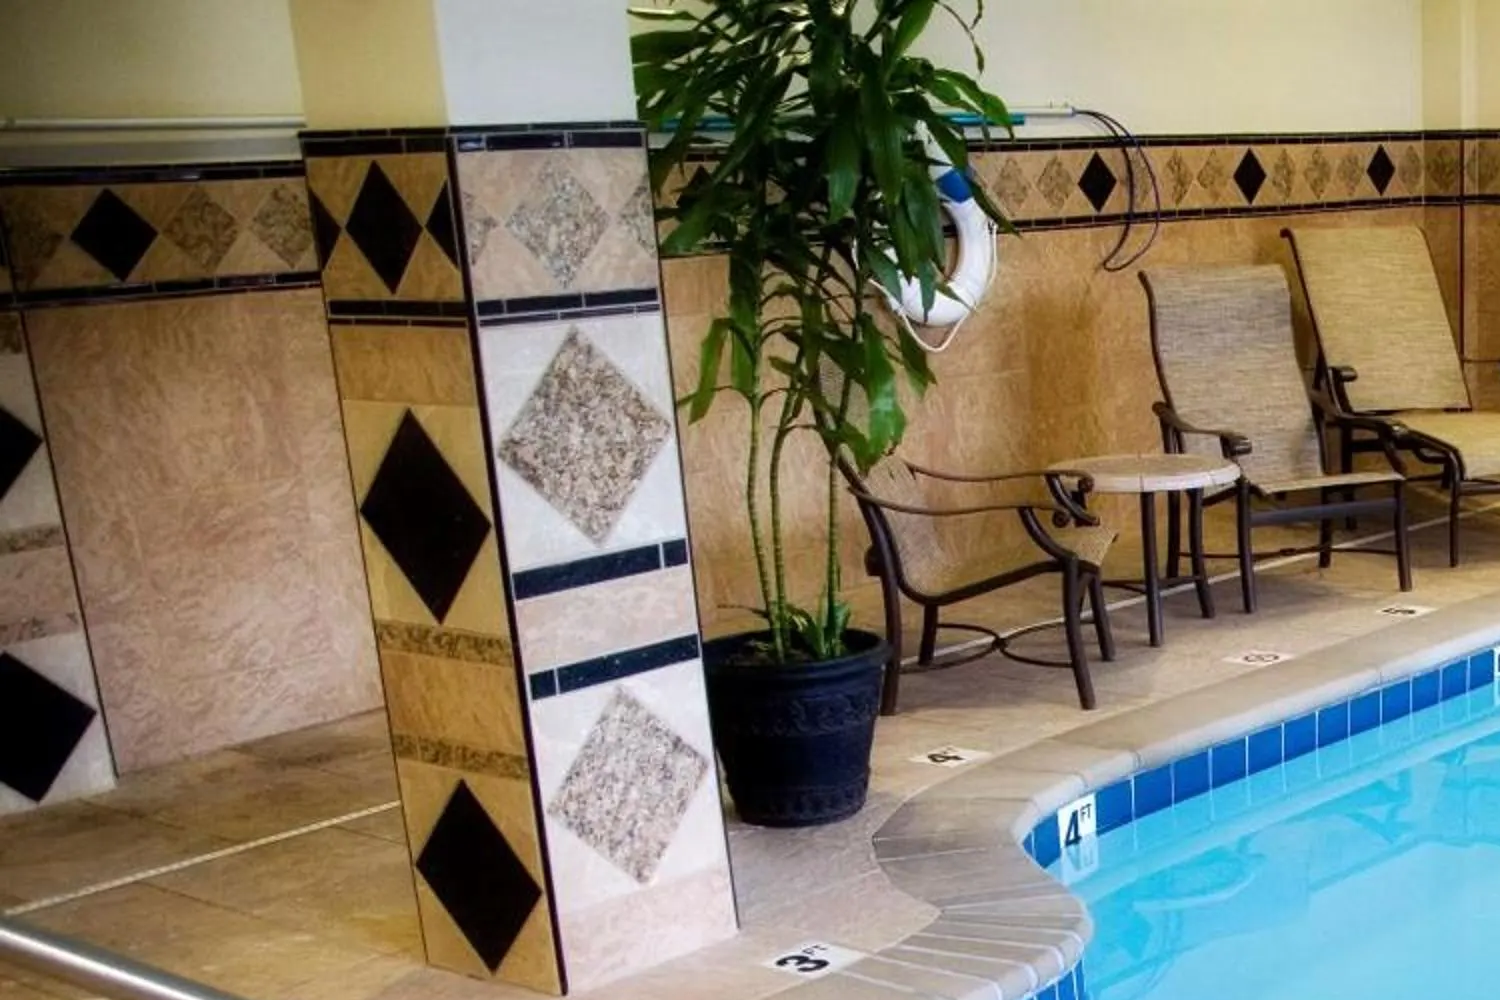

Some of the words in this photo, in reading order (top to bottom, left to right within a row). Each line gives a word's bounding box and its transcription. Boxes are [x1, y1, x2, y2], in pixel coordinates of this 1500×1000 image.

[927, 753, 966, 763] 4
[1064, 809, 1083, 847] 4
[1080, 803, 1092, 823] FT
[775, 955, 829, 972] 3
